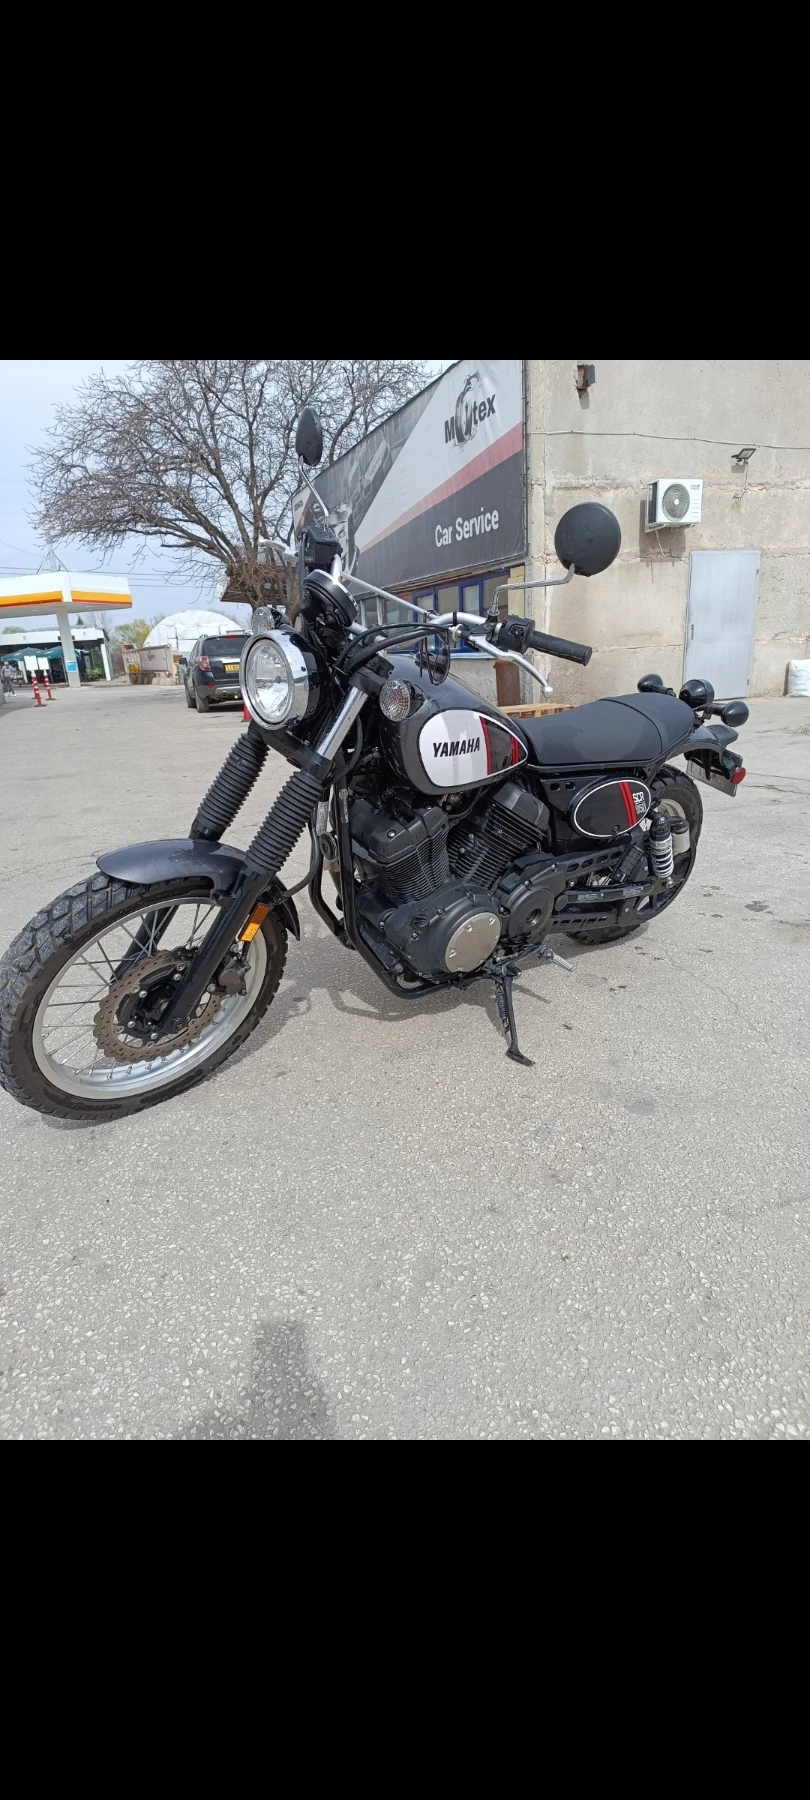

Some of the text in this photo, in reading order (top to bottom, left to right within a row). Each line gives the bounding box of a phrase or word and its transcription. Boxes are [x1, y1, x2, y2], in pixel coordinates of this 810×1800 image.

[435, 507, 499, 547] Car Service
[433, 736, 480, 758] YAMAHA
